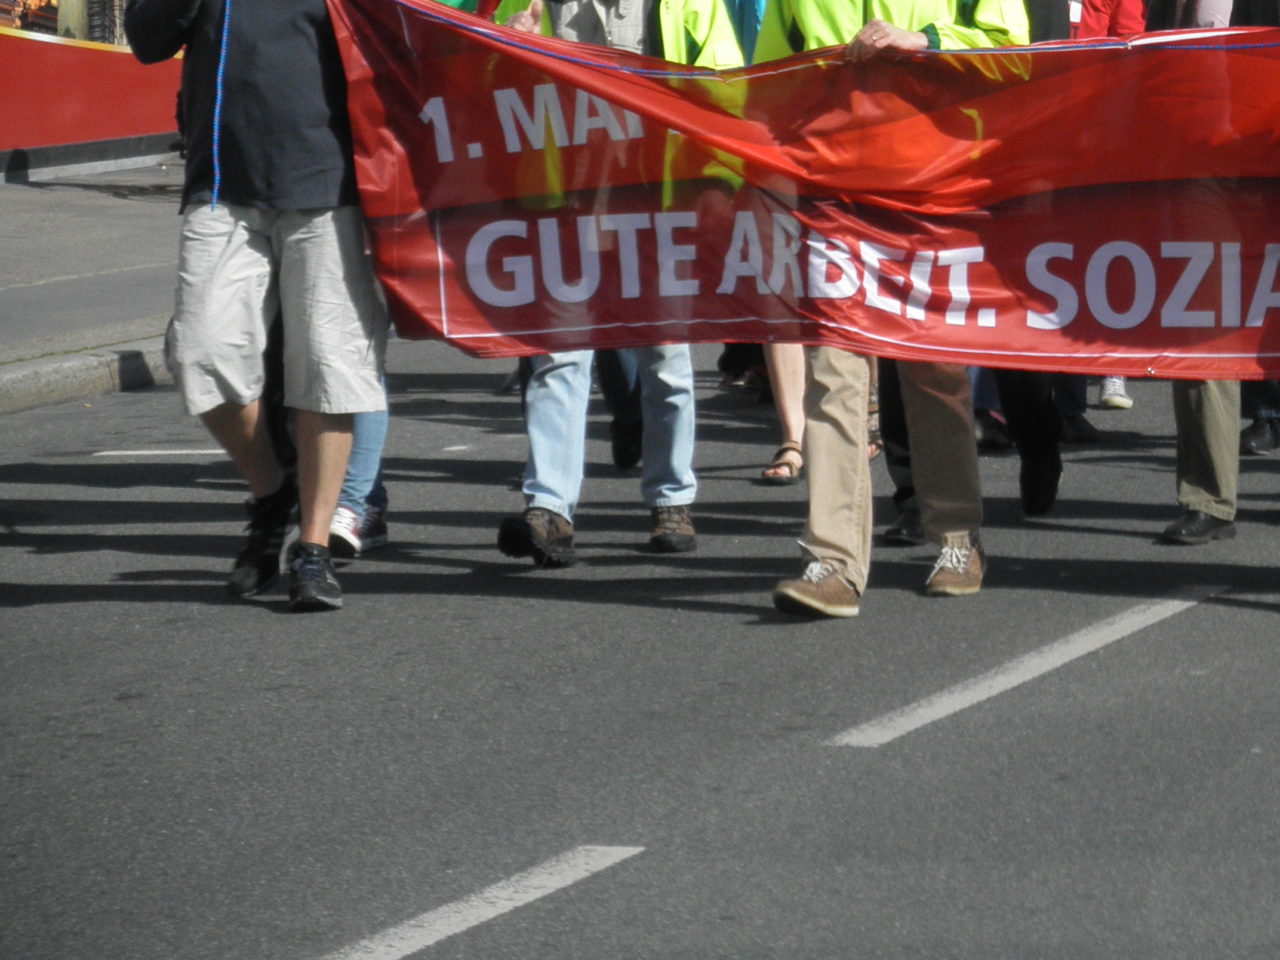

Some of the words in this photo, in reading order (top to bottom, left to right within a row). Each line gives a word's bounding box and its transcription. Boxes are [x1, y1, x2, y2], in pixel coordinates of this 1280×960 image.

[418, 96, 484, 163] 1.
[464, 211, 699, 308] GUTE
[716, 211, 998, 328] ARBEIT.
